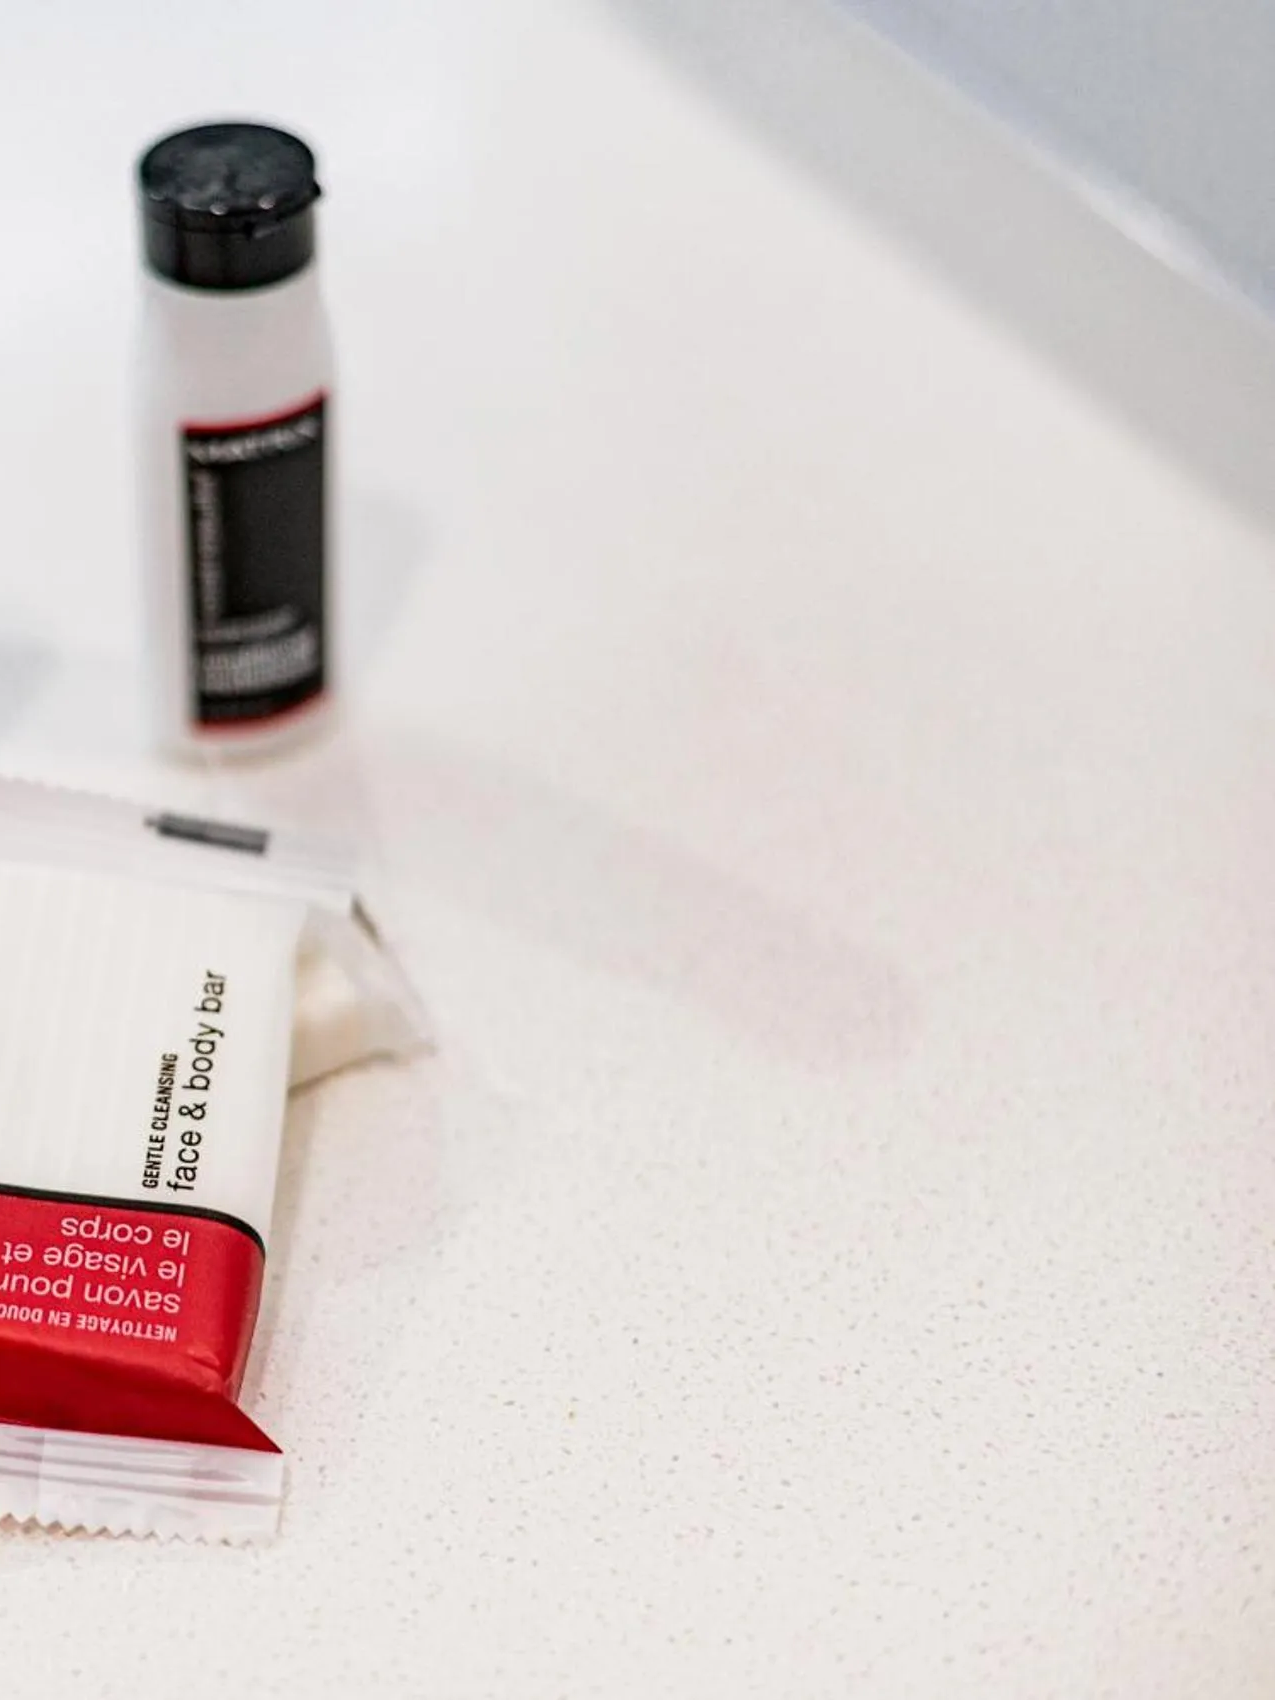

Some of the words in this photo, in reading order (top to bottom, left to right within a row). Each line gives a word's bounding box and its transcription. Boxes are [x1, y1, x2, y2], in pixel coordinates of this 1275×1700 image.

[195, 970, 226, 1014] bar
[181, 1021, 225, 1091] body
[150, 1052, 179, 1132] CLEANSING
[177, 1101, 207, 1121] &
[141, 1134, 166, 1189] GENTLE
[165, 1130, 203, 1193] face
[60, 1215, 152, 1245] corps
[163, 1229, 190, 1256] le
[1, 1241, 33, 1265] et
[43, 1243, 147, 1280] visage
[157, 1260, 185, 1287] le
[84, 1283, 181, 1313] savon
[47, 1311, 71, 1327] EN
[76, 1314, 178, 1342] NETTOYAGE
